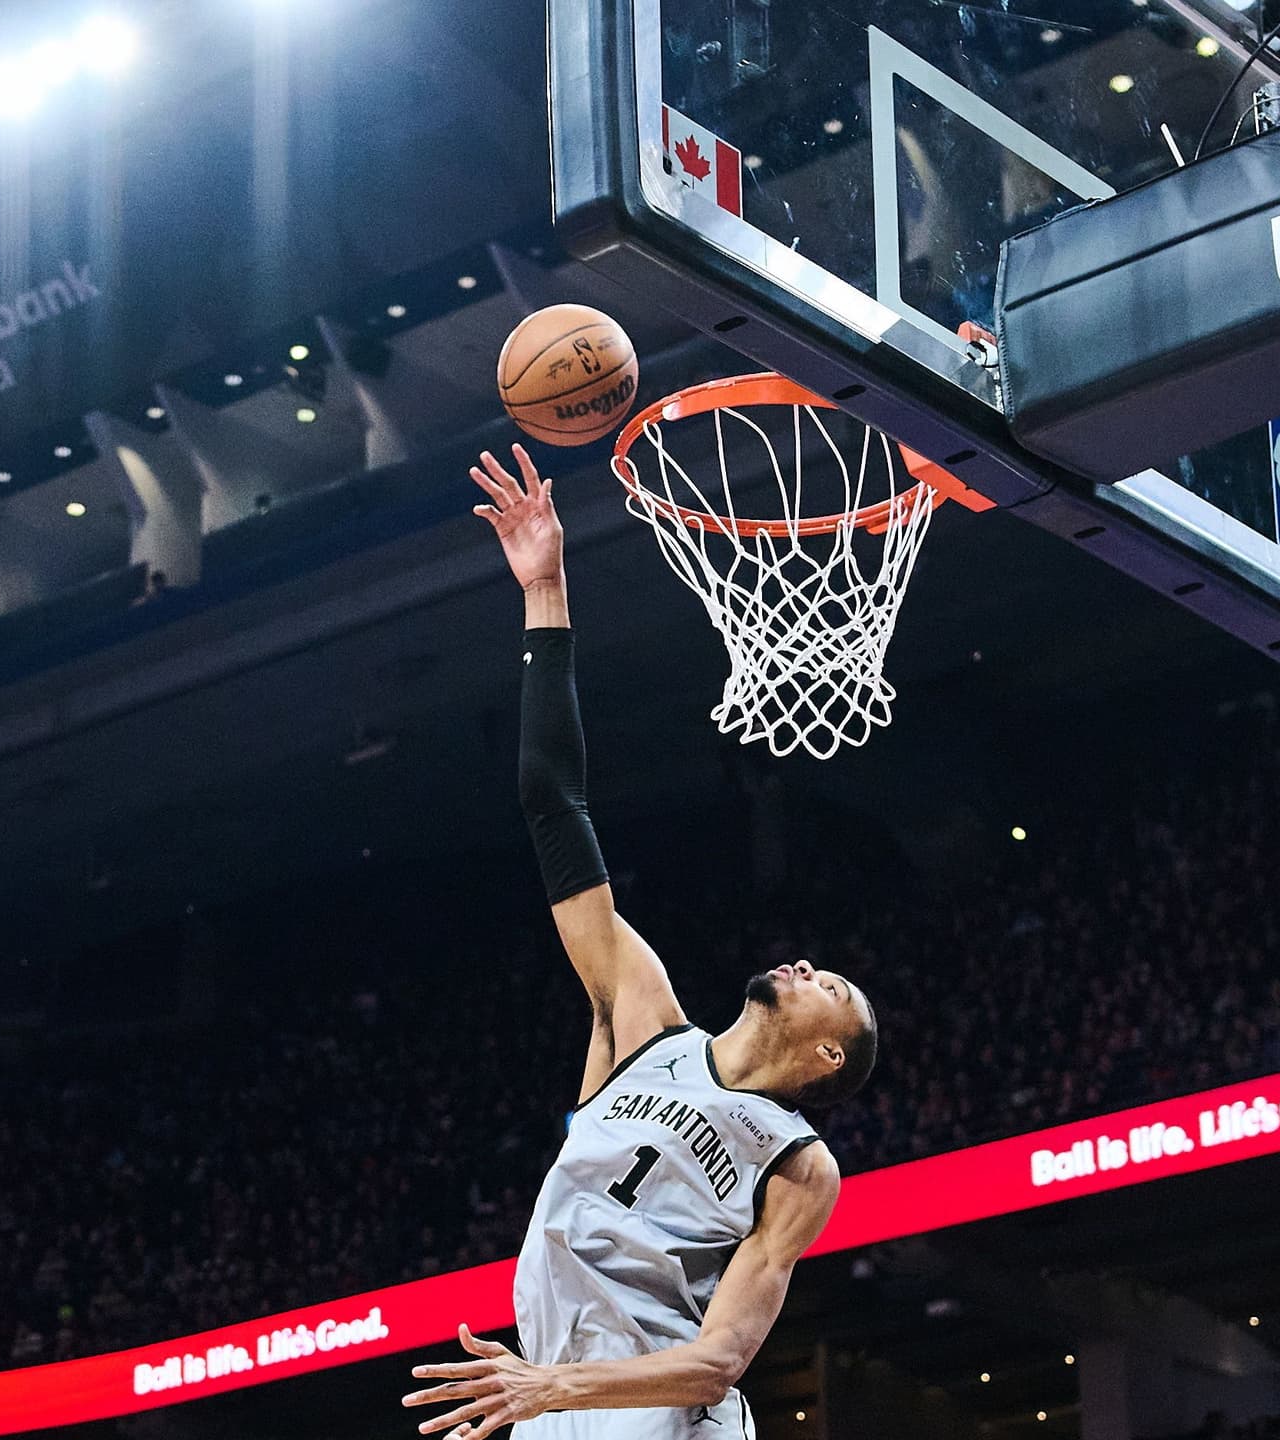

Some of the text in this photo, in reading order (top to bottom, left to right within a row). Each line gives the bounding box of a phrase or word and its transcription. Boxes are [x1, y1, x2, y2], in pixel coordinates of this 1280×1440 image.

[602, 1094, 740, 1203] SAN ANTONIO
[735, 1110, 766, 1143] LEDGER
[1031, 1139, 1096, 1187] Ball
[1097, 1135, 1129, 1171] is
[1128, 1122, 1195, 1164] life.
[1199, 1096, 1280, 1147] Life's
[607, 1144, 662, 1210] 1
[133, 1306, 390, 1396] Ball is life. Life's Good.
